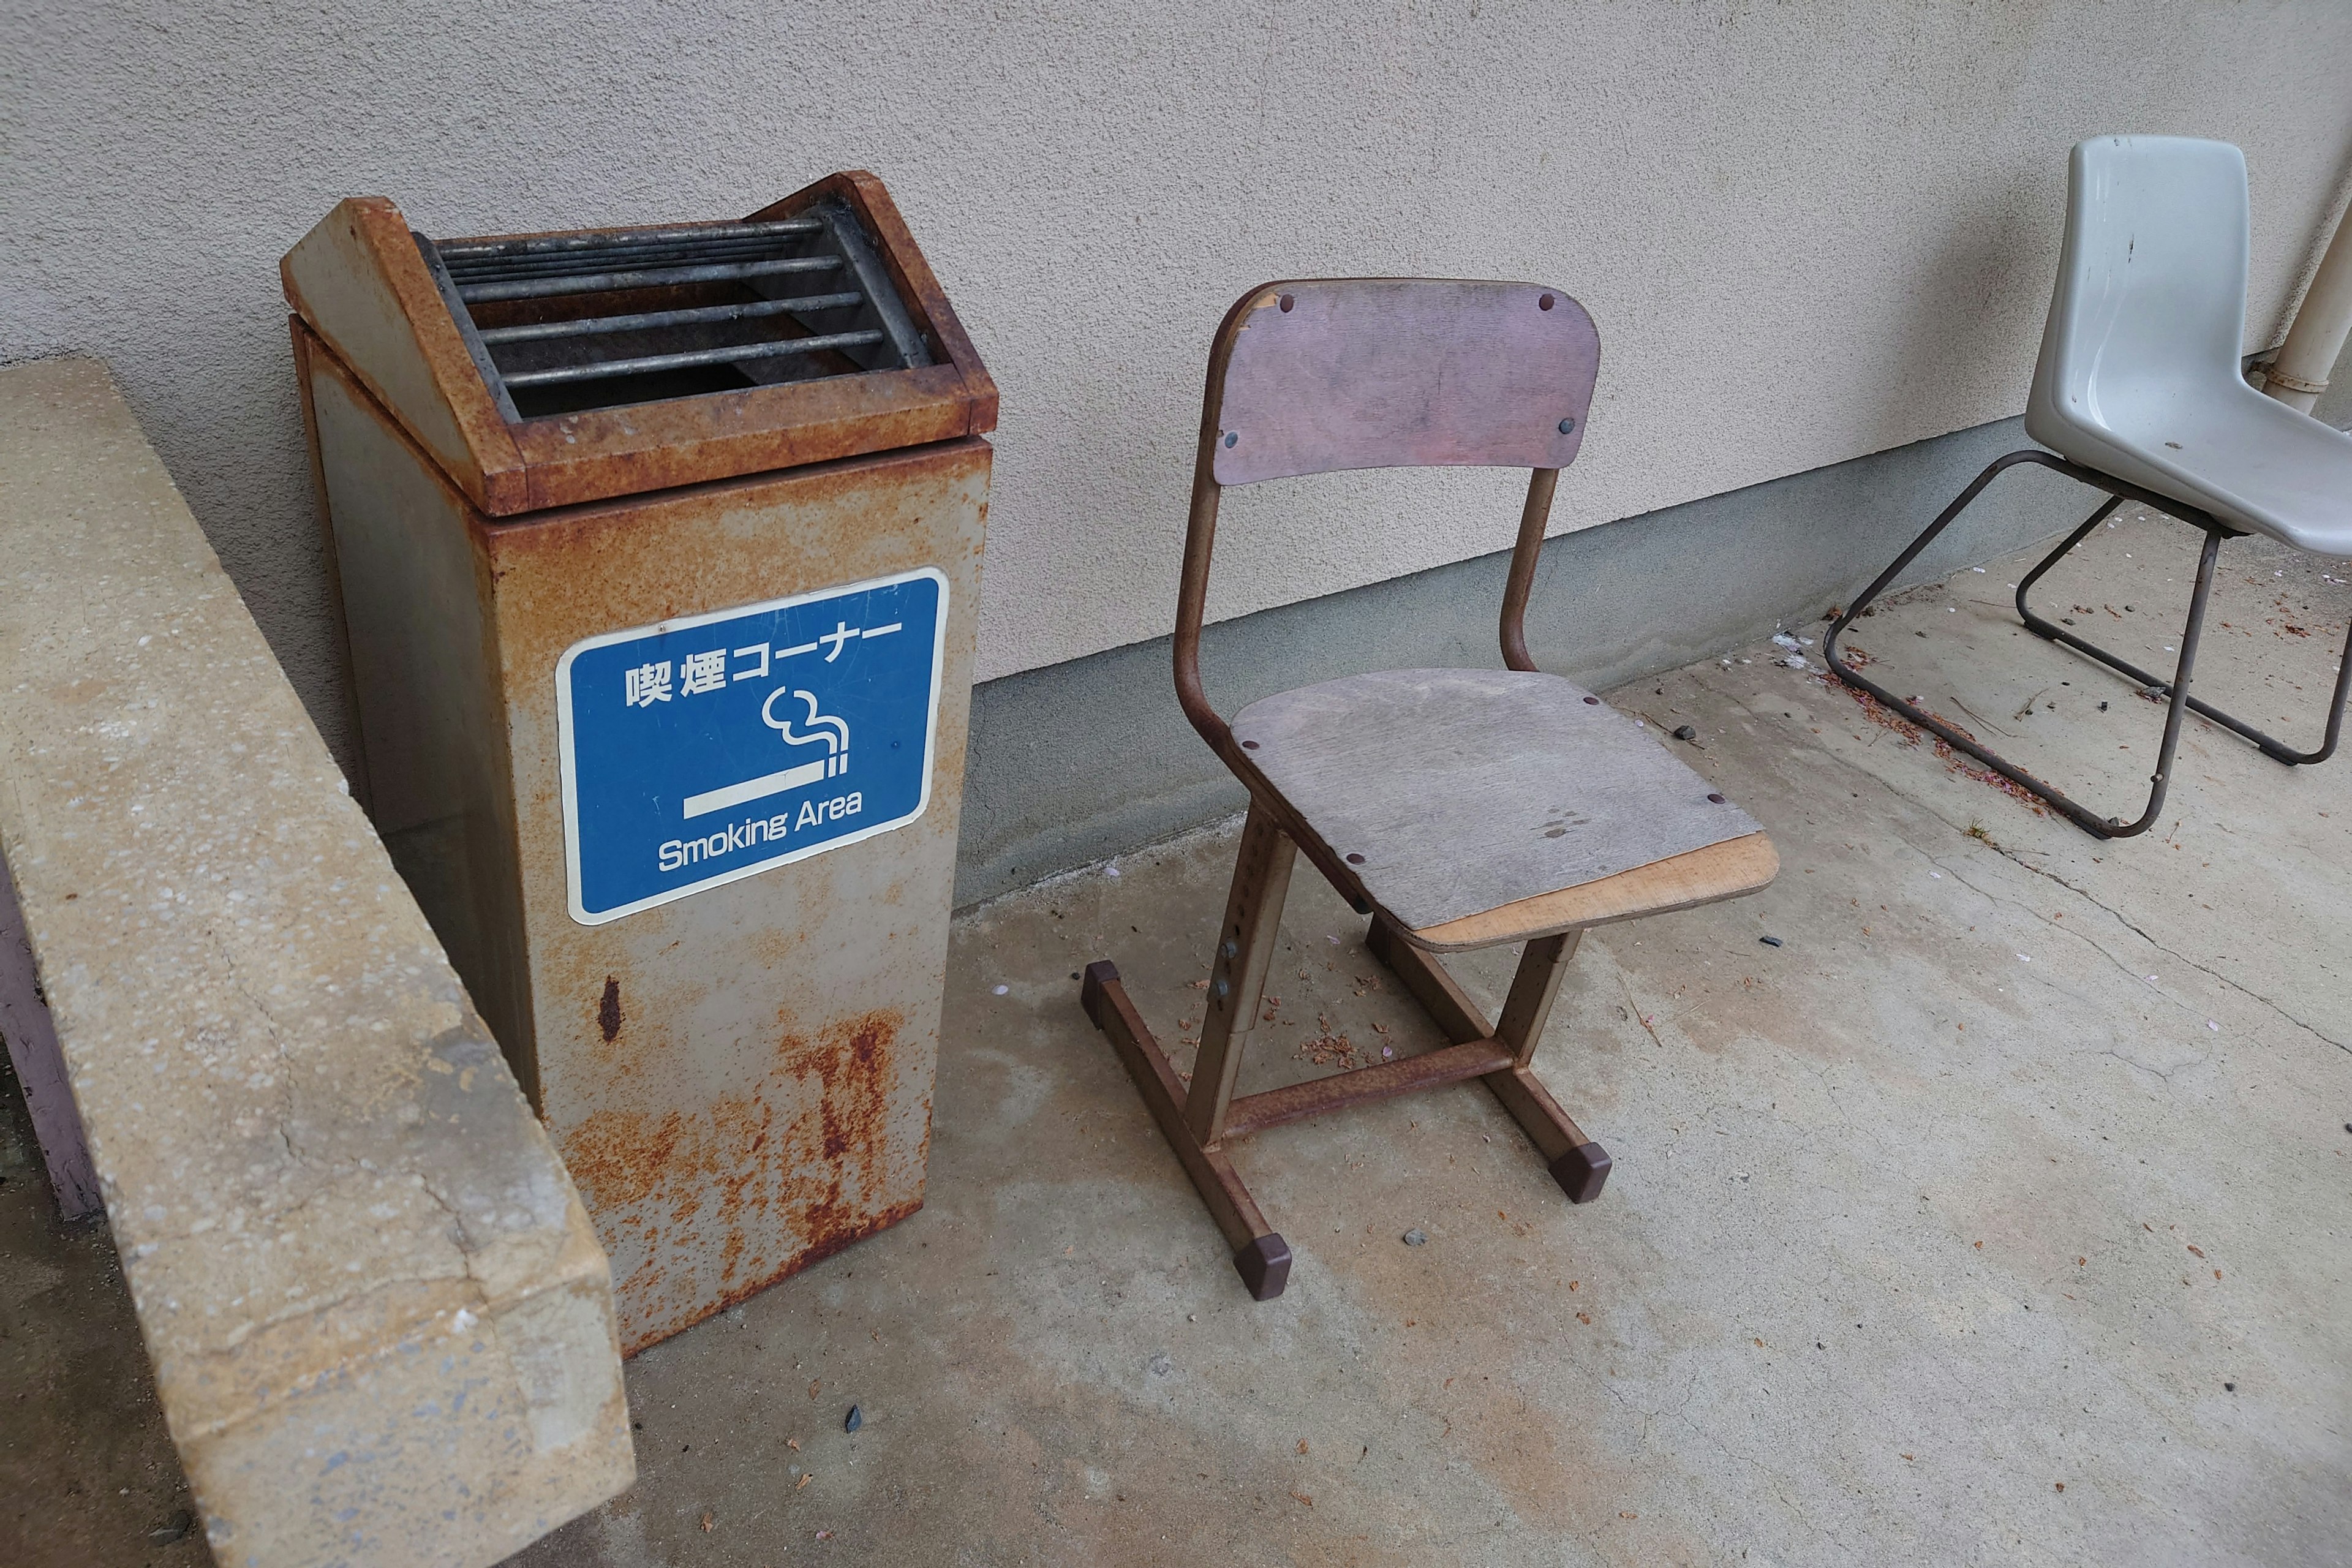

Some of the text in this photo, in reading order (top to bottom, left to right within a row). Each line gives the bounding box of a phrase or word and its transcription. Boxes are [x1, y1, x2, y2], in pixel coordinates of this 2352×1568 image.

[625, 621, 902, 707] 喫煙コーナー
[658, 791, 862, 872] Smoking Area
